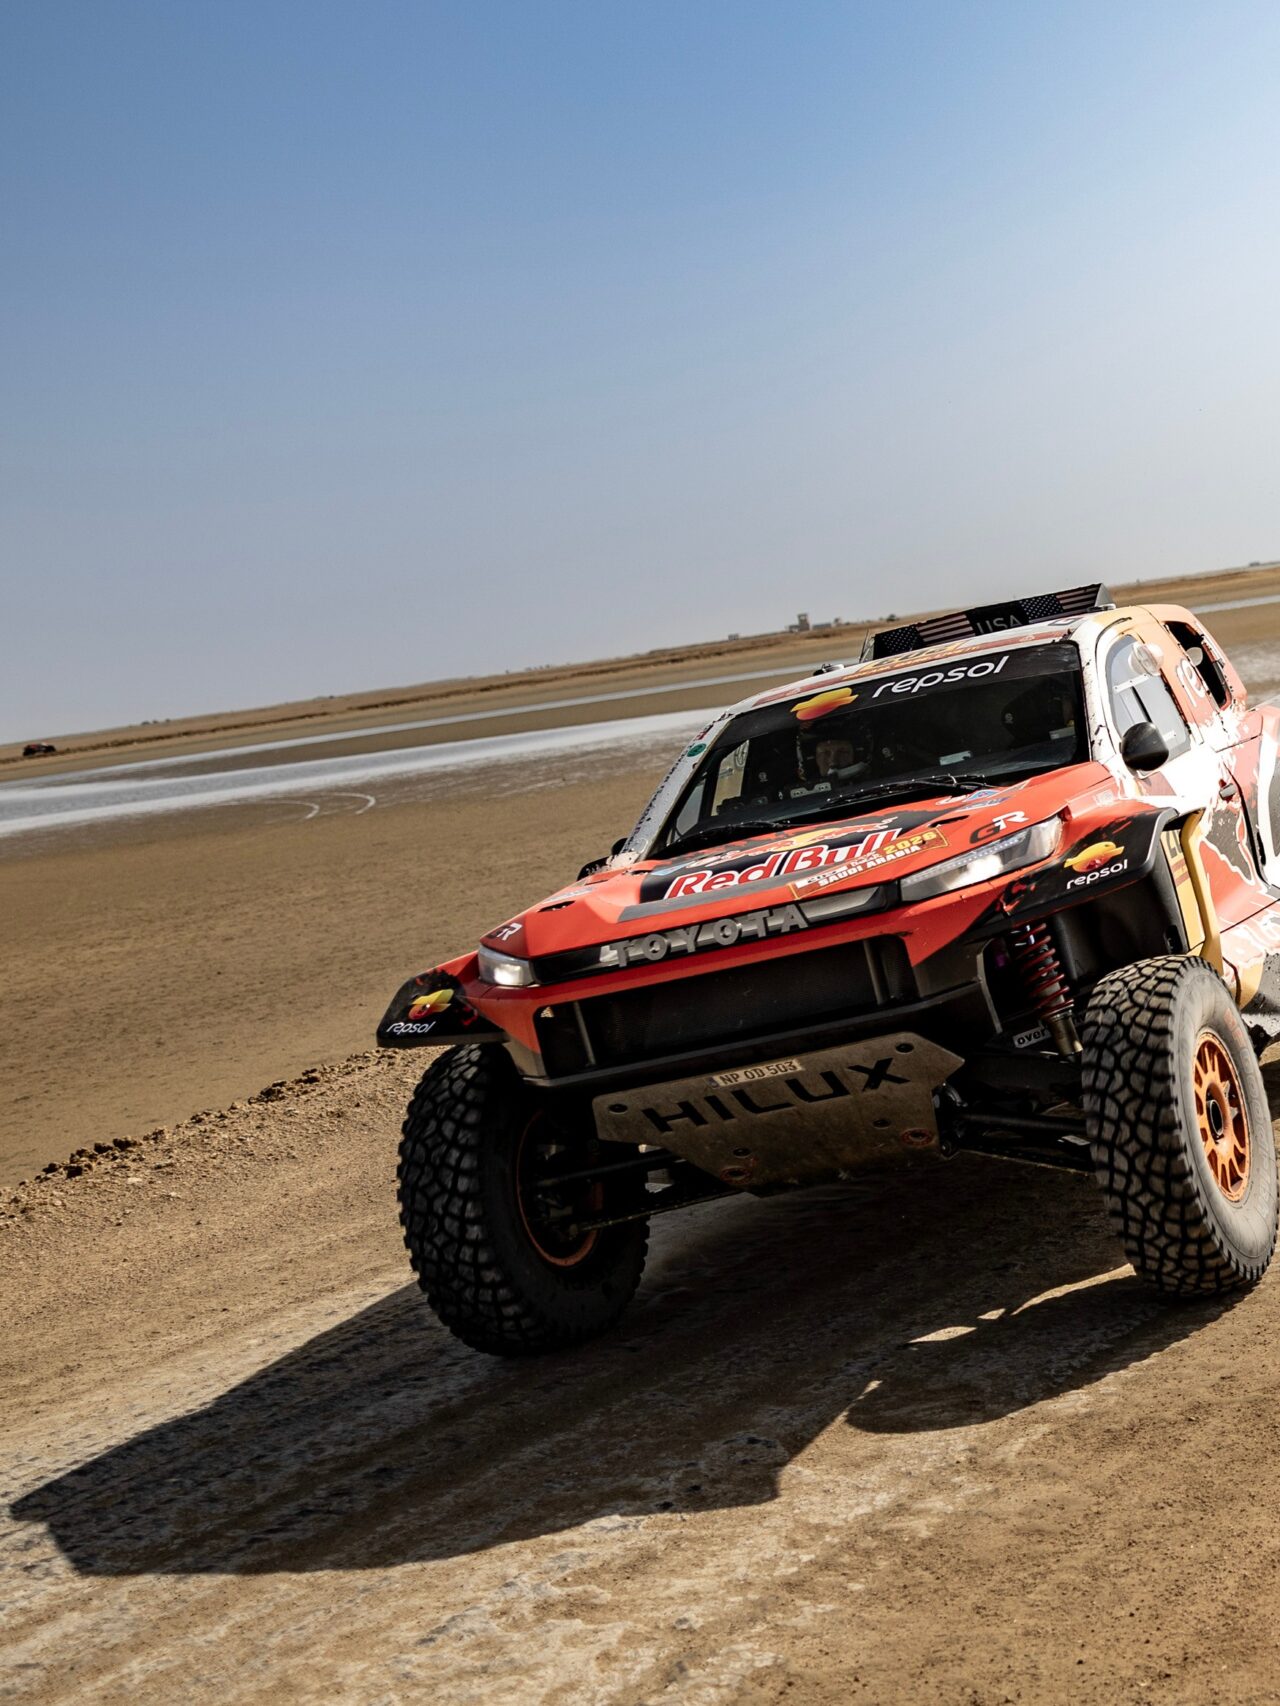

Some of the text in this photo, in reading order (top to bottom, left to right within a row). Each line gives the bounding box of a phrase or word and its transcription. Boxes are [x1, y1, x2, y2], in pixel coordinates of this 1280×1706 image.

[976, 614, 1023, 635] USA
[872, 655, 1009, 699] repsol
[883, 831, 937, 855] 2026
[969, 811, 1029, 844] GR
[663, 851, 788, 900] Red
[780, 828, 903, 876] Bull
[819, 866, 863, 887] SAUDI
[866, 845, 921, 868] ARABIA
[1066, 859, 1128, 890] repsol
[609, 904, 809, 968] TOYOTA
[719, 1072, 740, 1086] NP
[766, 1061, 798, 1075] 503
[642, 1057, 911, 1133] HILUX
